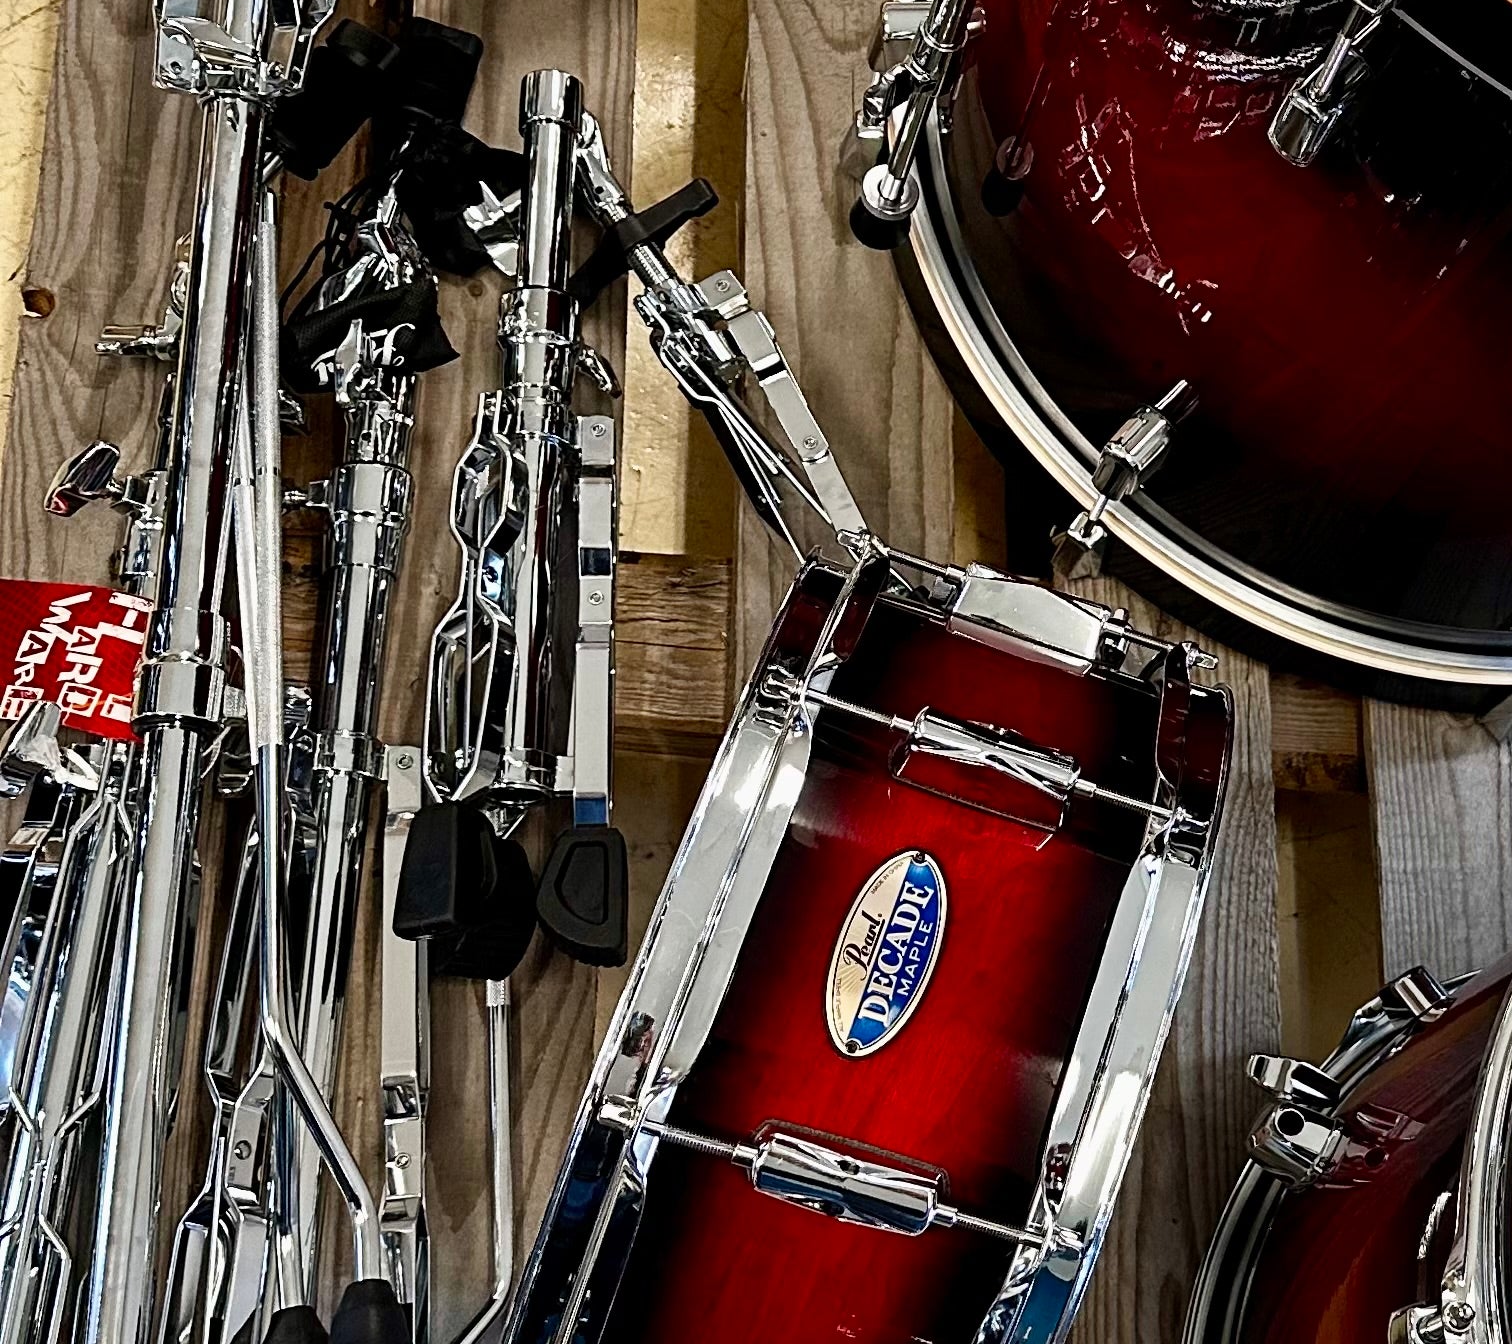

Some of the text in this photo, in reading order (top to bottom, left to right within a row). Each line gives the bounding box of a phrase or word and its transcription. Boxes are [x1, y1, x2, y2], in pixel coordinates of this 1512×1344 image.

[843, 909, 883, 981] Pearl
[857, 880, 935, 1028] DECADE
[896, 919, 934, 996] MAPLE
